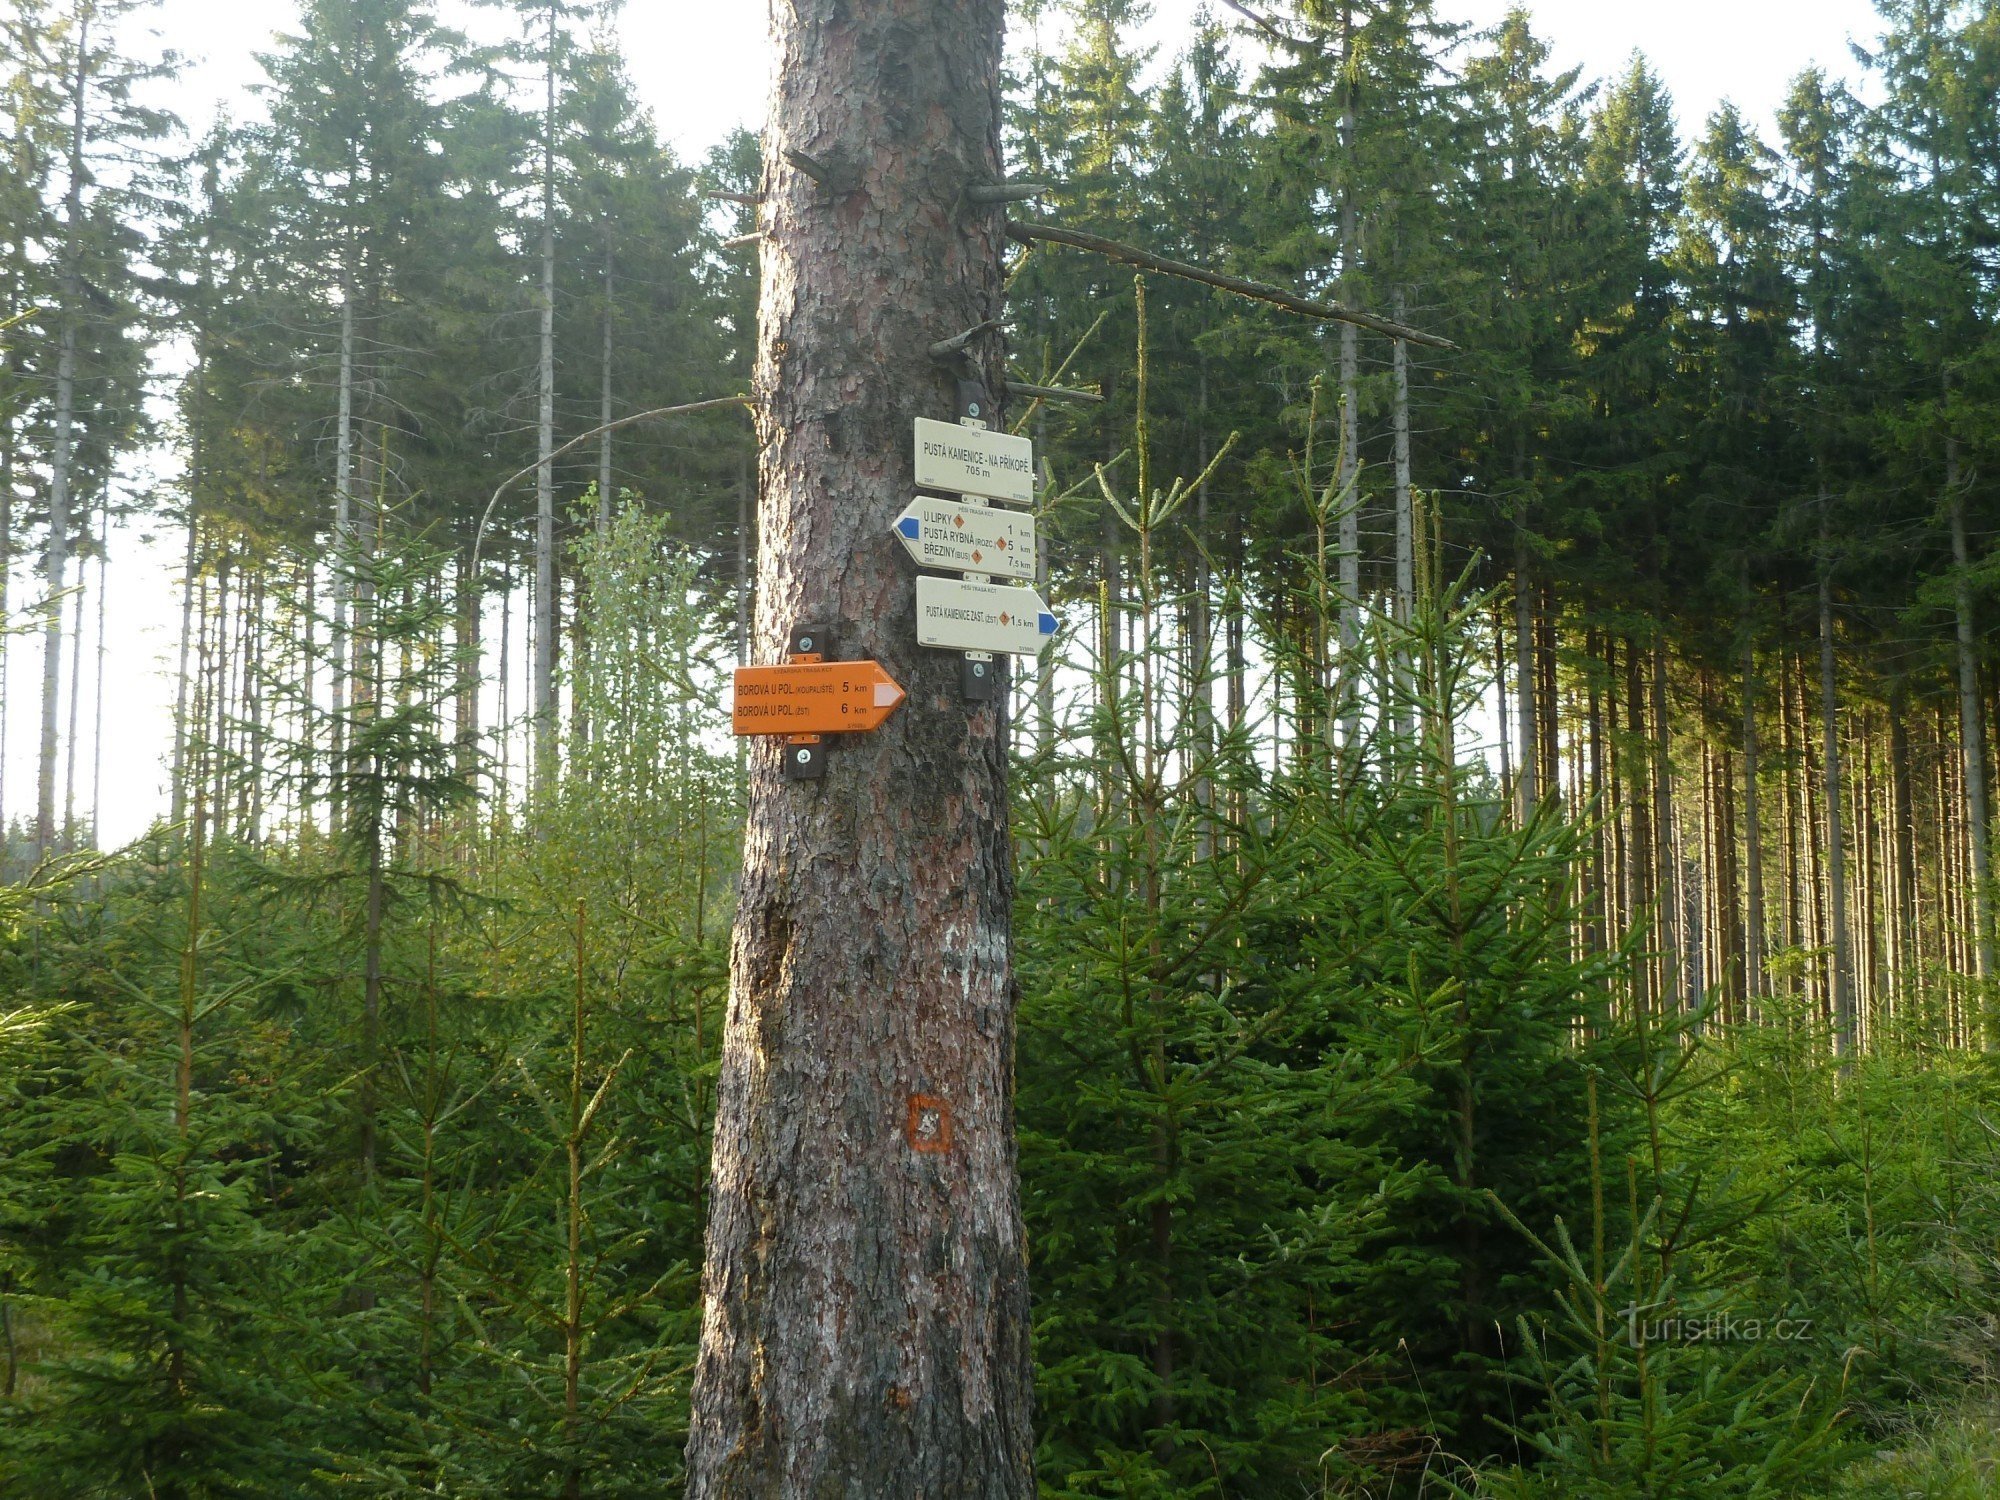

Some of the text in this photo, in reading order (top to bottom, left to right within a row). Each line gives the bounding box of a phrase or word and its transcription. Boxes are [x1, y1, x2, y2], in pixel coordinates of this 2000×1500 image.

[924, 442, 947, 458] PUSTÁ
[948, 446, 983, 465] KAMENICE
[989, 455, 998, 467] NA
[999, 454, 1029, 473] PŘÍKOPĚ
[965, 465, 991, 478] 705 m
[924, 511, 1031, 538] U LIPKY 1 km
[924, 527, 948, 541] PUSTÁ
[950, 532, 975, 545] RYBNÁ
[1008, 541, 1014, 551] 5
[1020, 545, 1031, 554] km
[1020, 560, 1031, 569] km
[926, 604, 943, 618] PUSTÁ
[944, 607, 970, 621] KAMENICE
[971, 610, 984, 622] ZAST.
[1023, 619, 1034, 628] km
[738, 683, 770, 696] BOROVÁ
[771, 685, 777, 695] U
[778, 683, 795, 695] POL.
[842, 681, 849, 693] 5
[854, 684, 867, 693] km
[737, 702, 769, 717] BOROVÁ
[770, 706, 776, 716] U
[778, 704, 794, 716] POL.
[841, 703, 848, 714] 6
[854, 706, 867, 714] km
